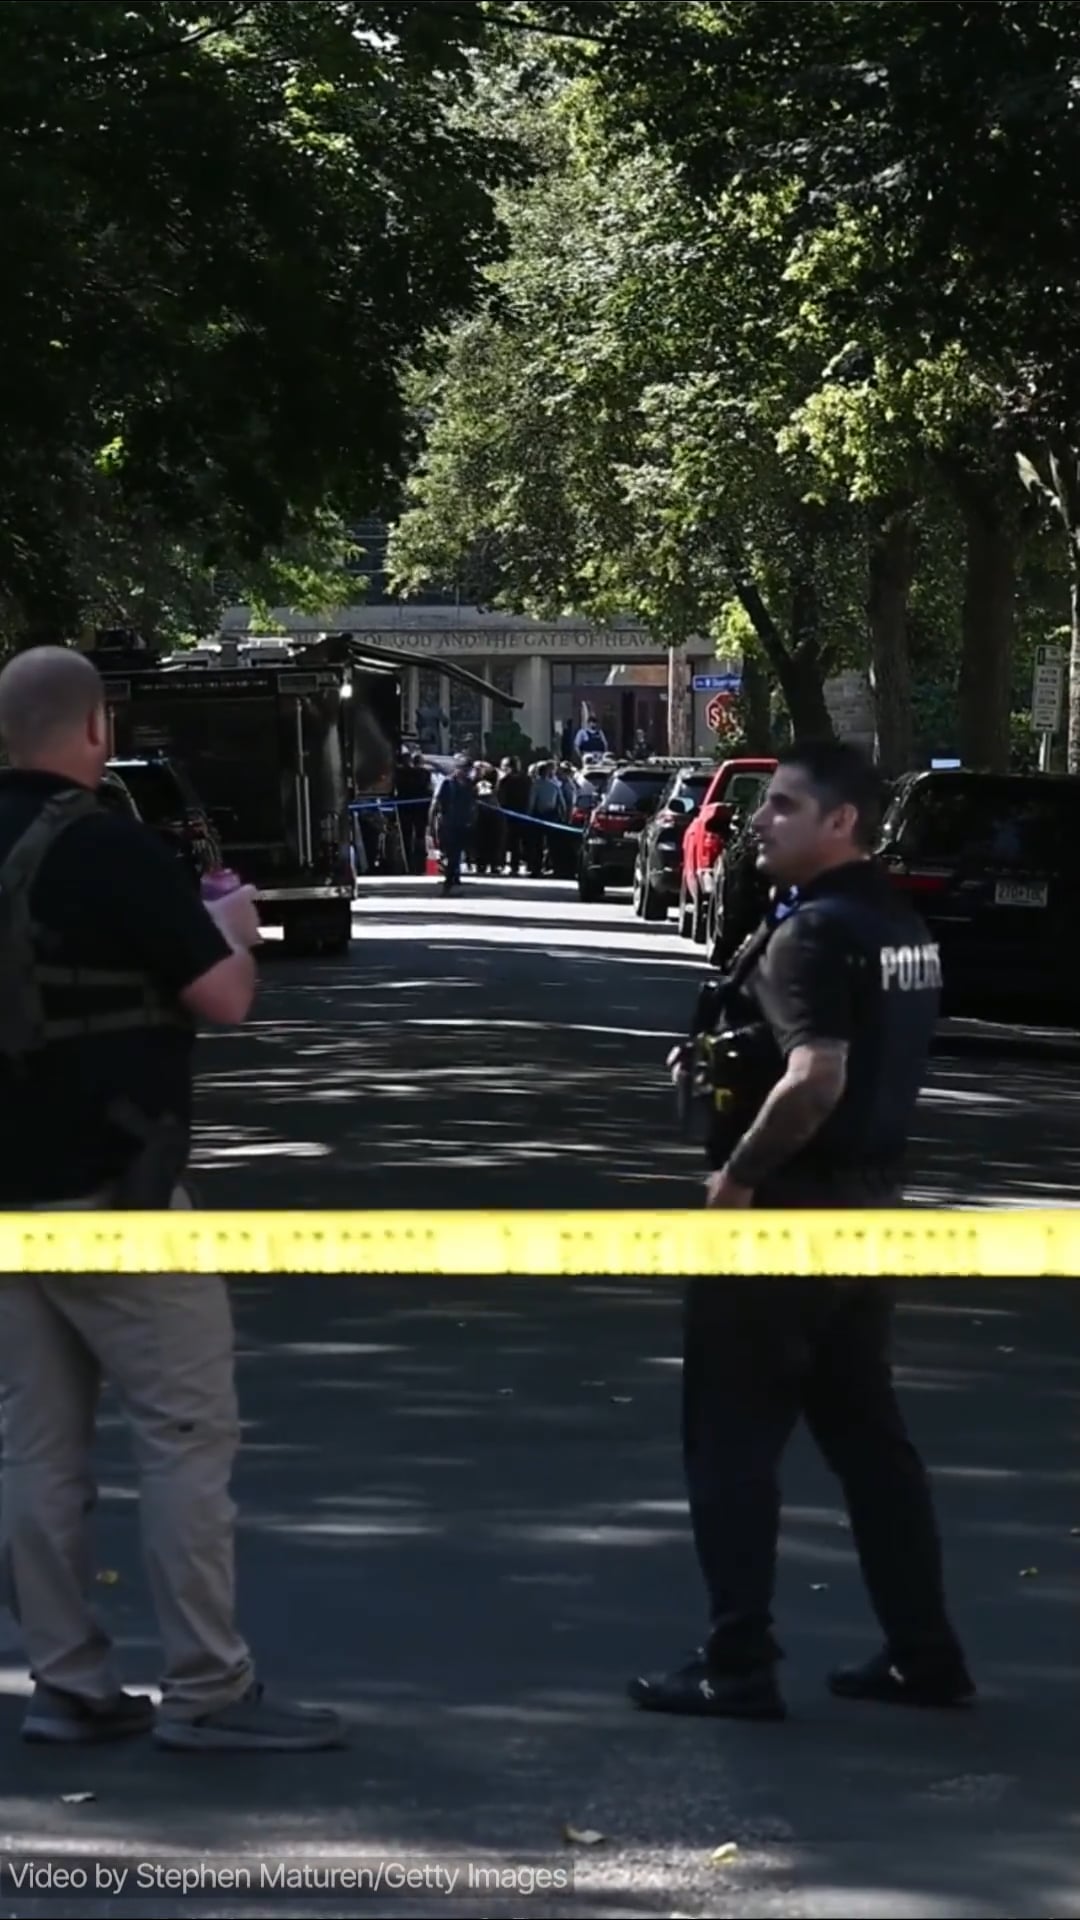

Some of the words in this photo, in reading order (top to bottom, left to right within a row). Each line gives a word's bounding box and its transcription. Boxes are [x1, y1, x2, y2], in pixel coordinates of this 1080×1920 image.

[394, 632, 432, 648] GOD
[438, 632, 476, 648] AND
[485, 631, 520, 648] THE
[524, 631, 570, 648] GATE
[575, 632, 598, 648] OF
[605, 632, 654, 648] HEAV
